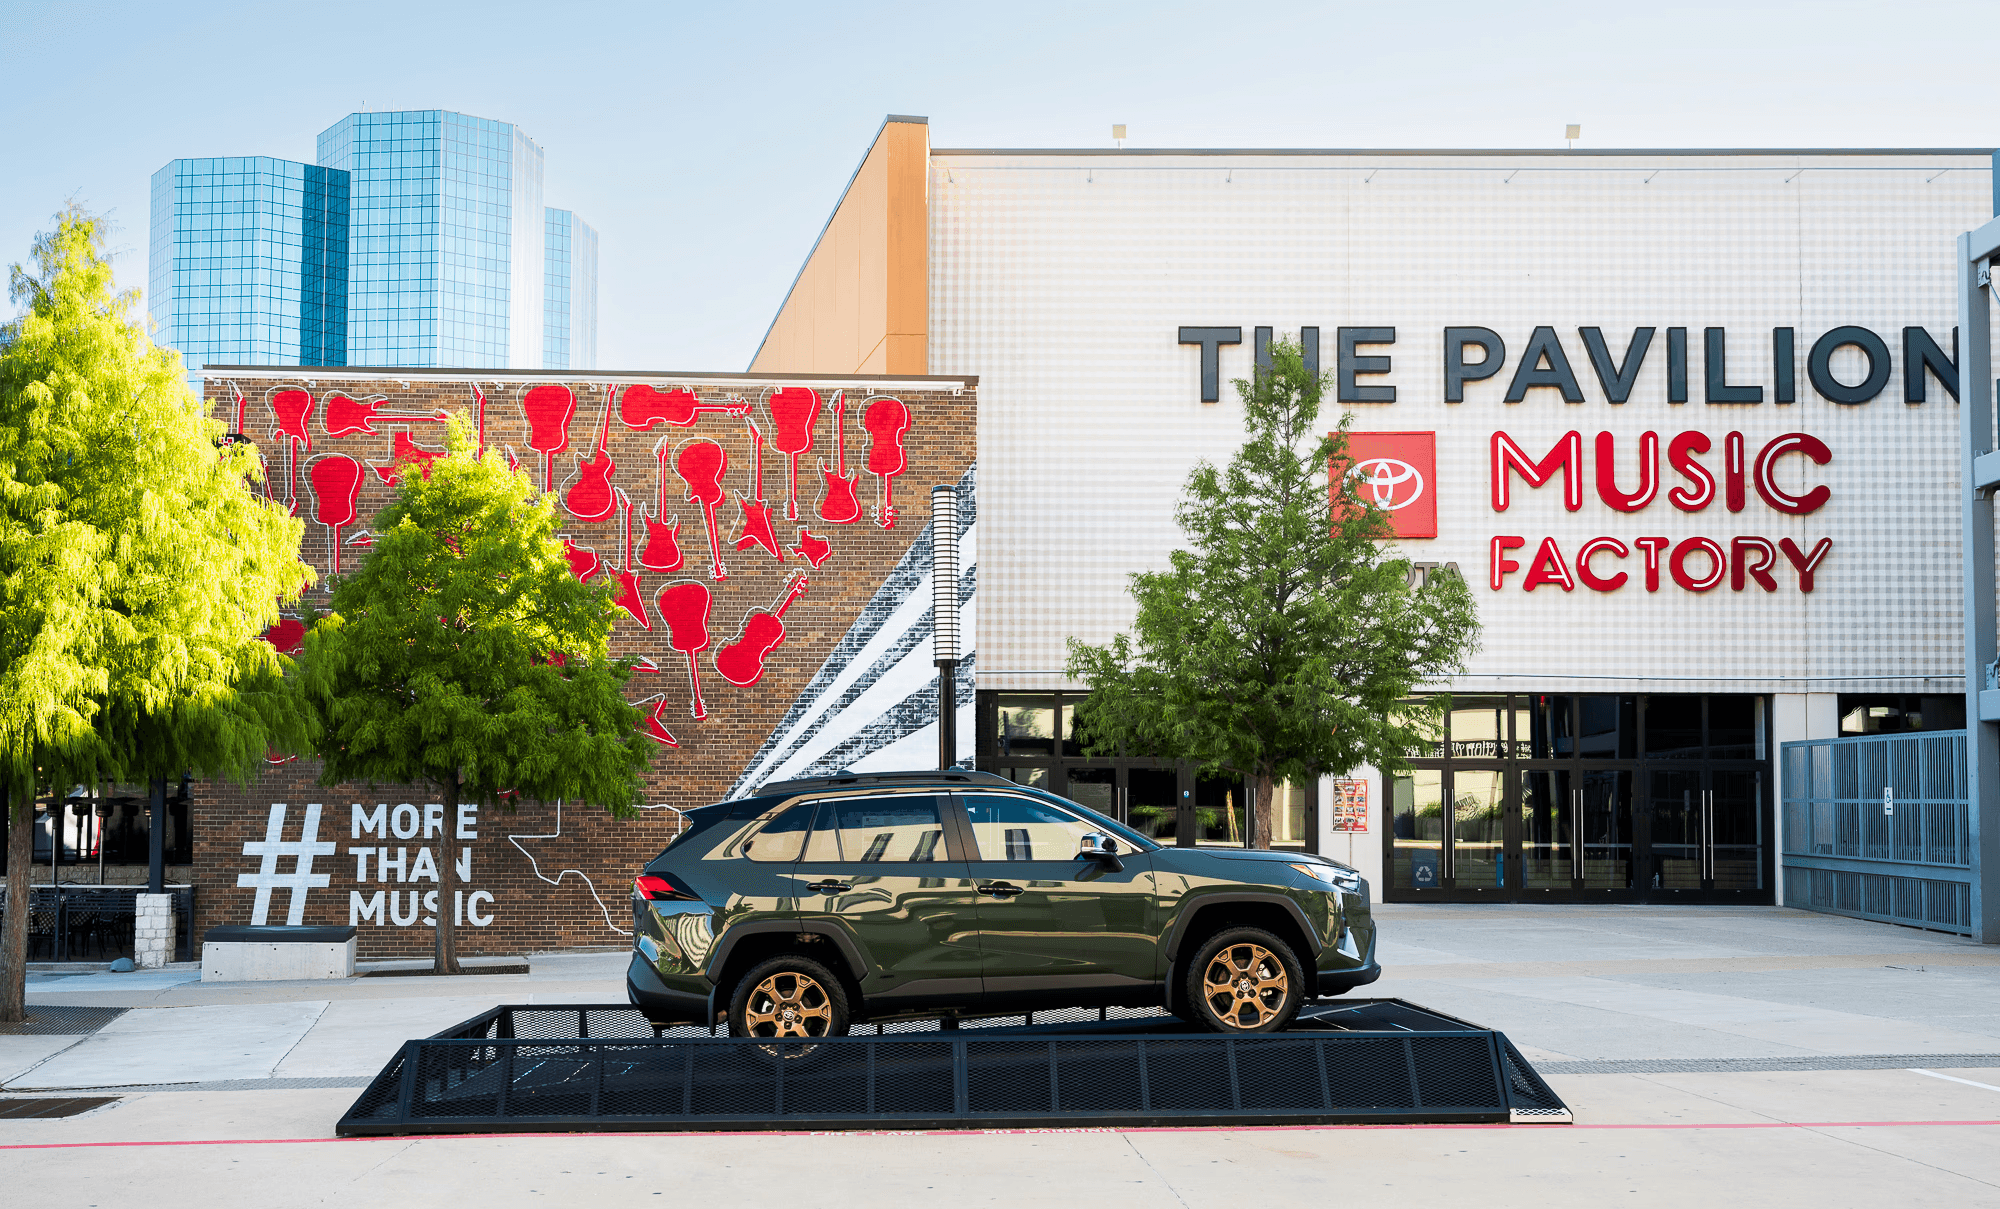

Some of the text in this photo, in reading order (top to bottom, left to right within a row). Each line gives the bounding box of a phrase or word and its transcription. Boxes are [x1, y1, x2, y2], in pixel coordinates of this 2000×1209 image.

[1178, 325, 1960, 405] THE PAVILION
[1490, 430, 1832, 515] MUSIC
[1489, 535, 1833, 593] FACTORY
[351, 803, 478, 839] MORE
[236, 803, 337, 926] #
[349, 890, 495, 927] MUSIC
